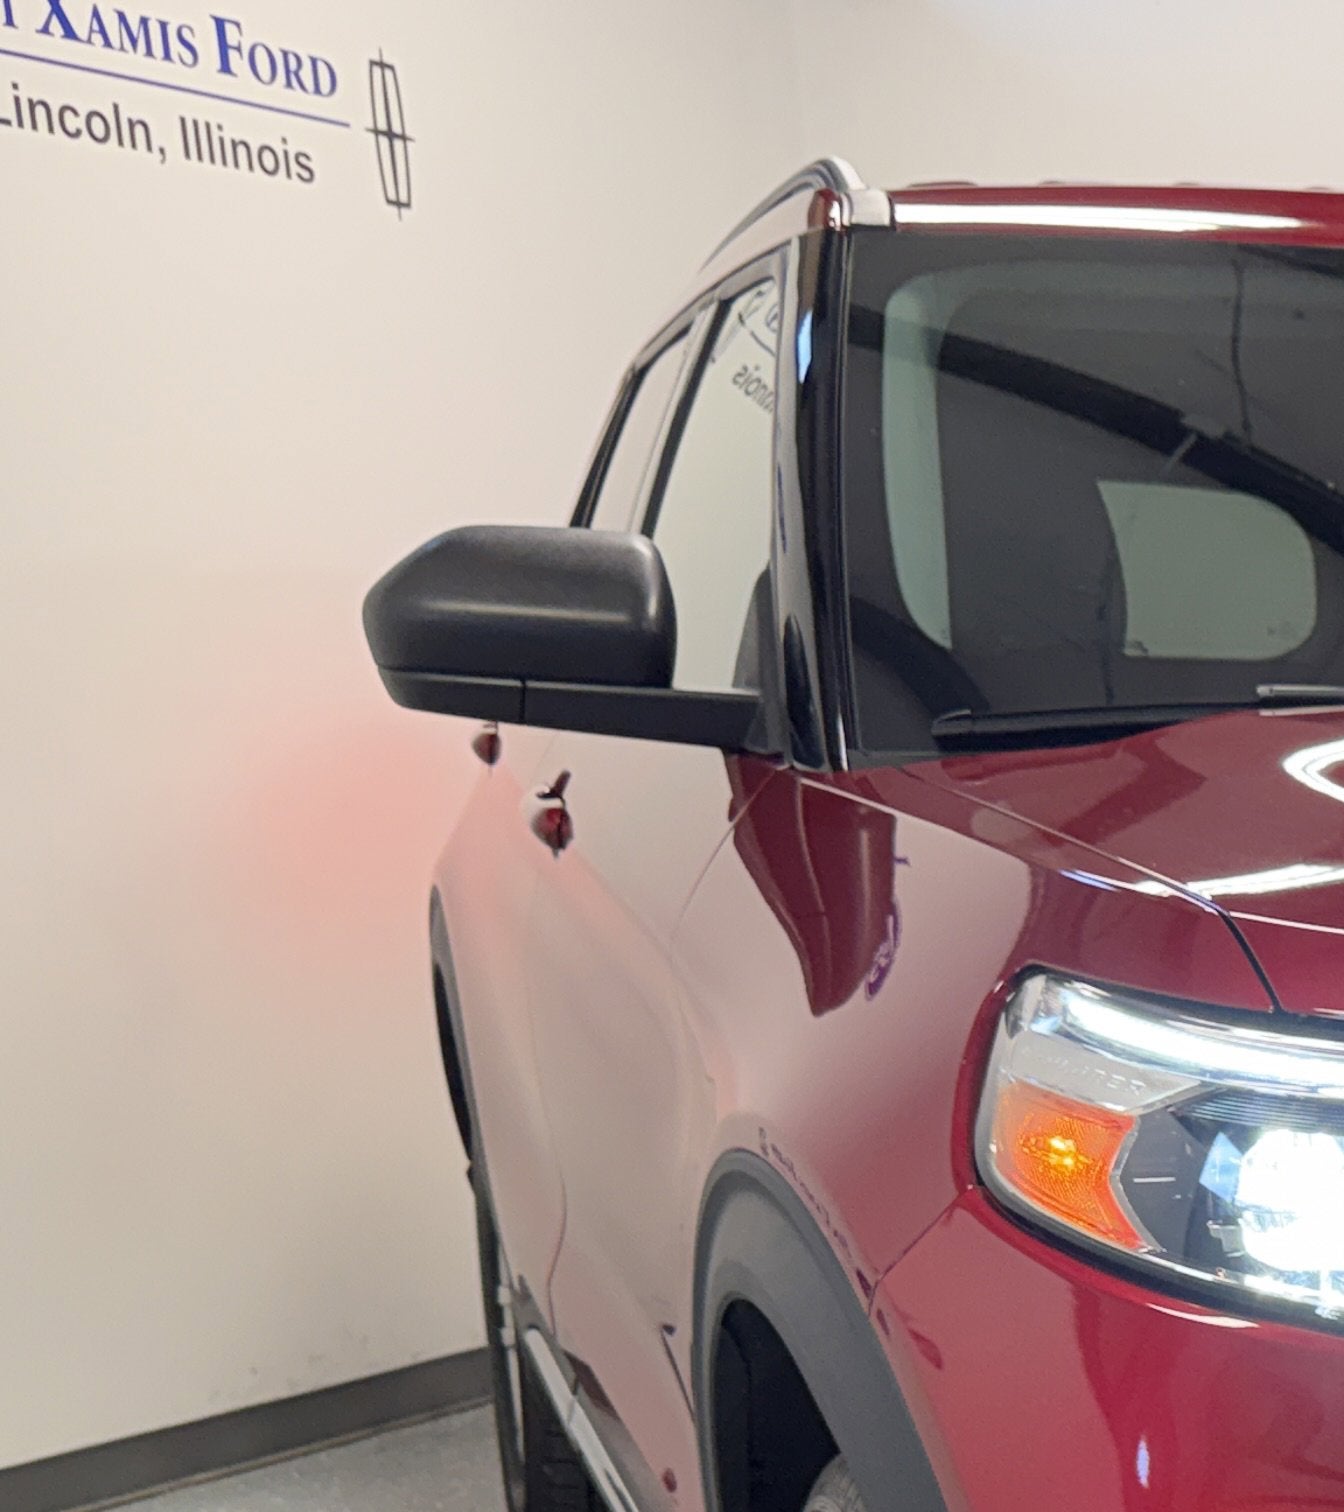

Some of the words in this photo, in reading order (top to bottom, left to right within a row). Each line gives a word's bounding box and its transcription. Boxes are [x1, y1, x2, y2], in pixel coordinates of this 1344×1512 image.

[35, 0, 199, 69] XAMIS
[209, 14, 338, 98] FORD
[0, 80, 167, 165] incoln,
[179, 115, 316, 184] Illinois
